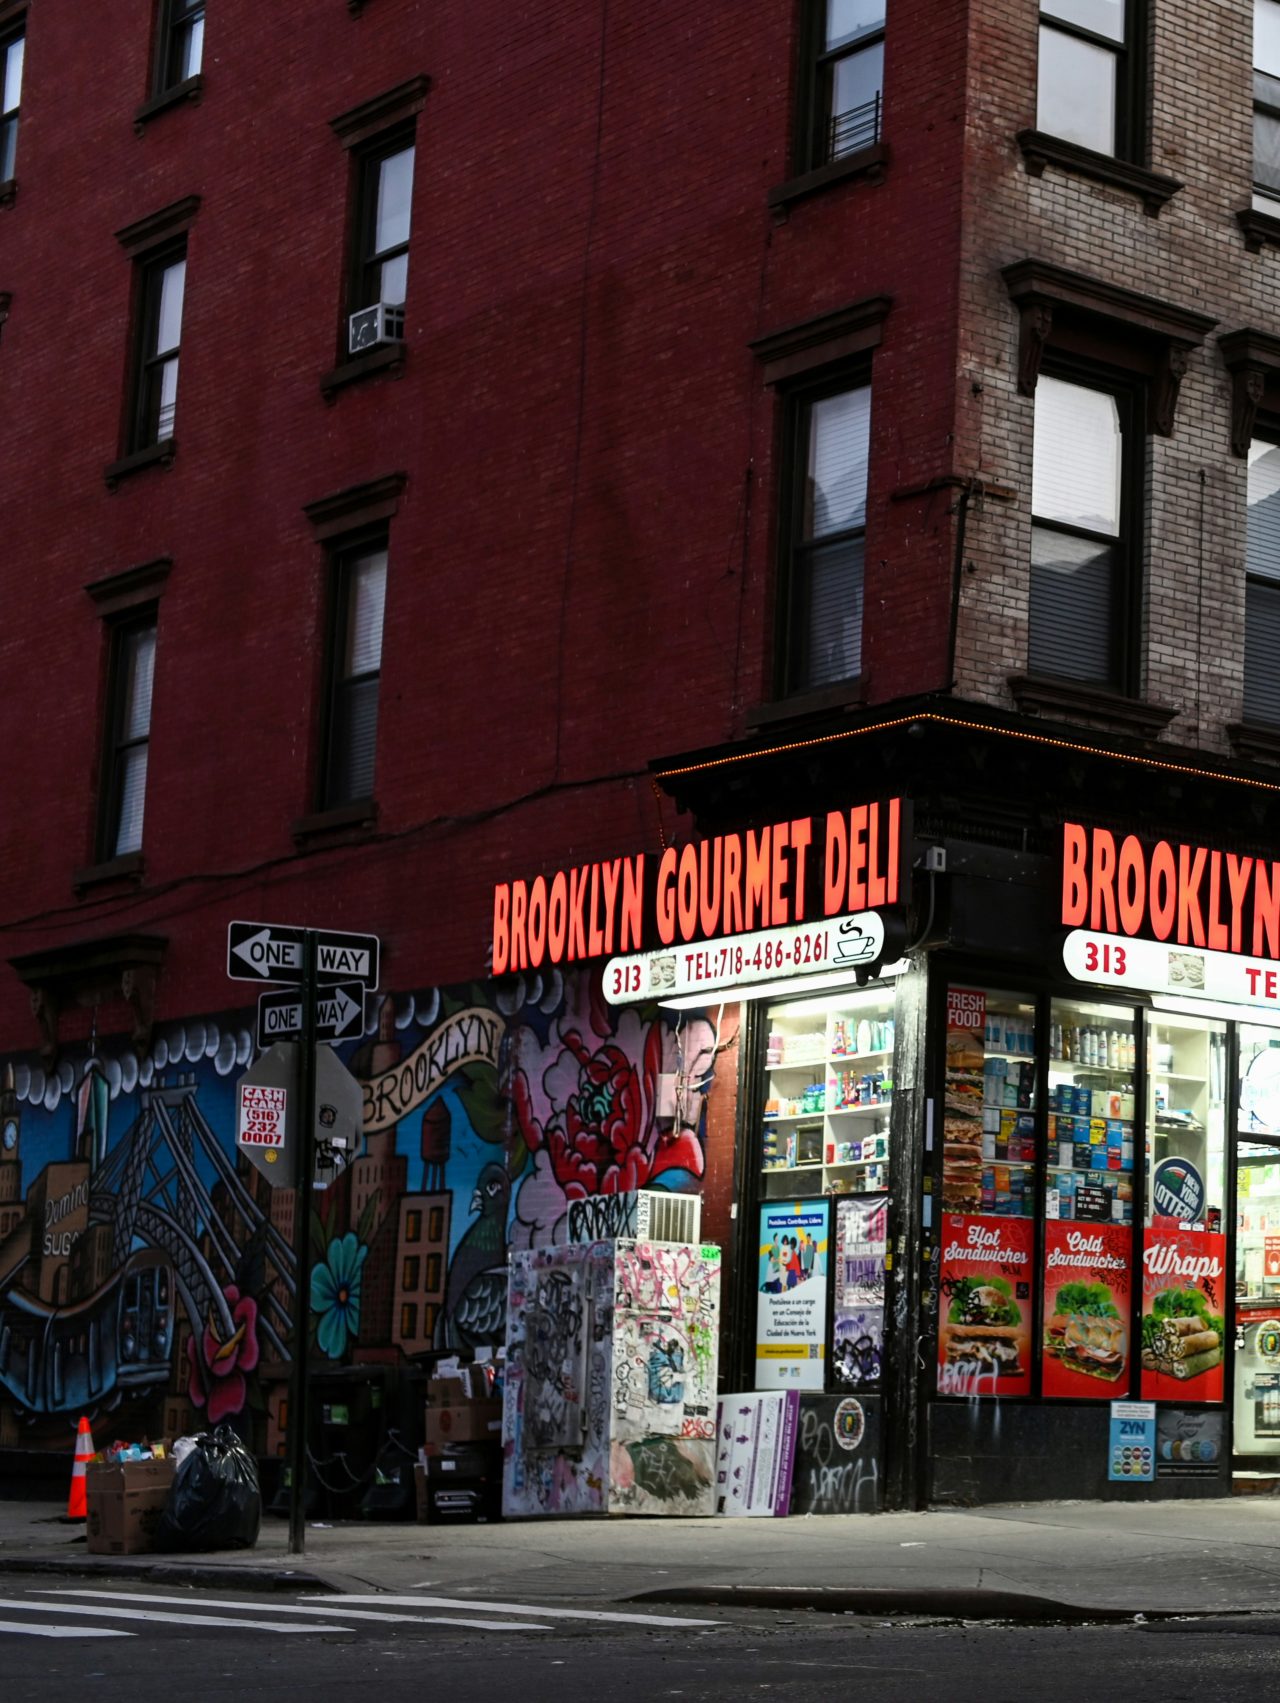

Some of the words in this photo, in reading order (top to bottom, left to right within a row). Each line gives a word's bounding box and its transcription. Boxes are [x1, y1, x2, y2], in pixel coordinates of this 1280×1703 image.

[492, 853, 644, 976] BROOKLYN
[656, 817, 812, 945] GOURMET
[824, 797, 901, 916] DELI
[250, 942, 295, 966] ONE
[320, 947, 365, 972] WAY
[612, 965, 643, 995] 313
[685, 932, 829, 983] TEL:718-486-8261
[1085, 943, 1127, 976] 313
[947, 992, 984, 1011] FRESH
[268, 1007, 298, 1030] ONE
[317, 1001, 349, 1024] WAY
[948, 1009, 981, 1027] FOOD
[362, 1014, 498, 1124] BROOKLYN
[244, 1099, 283, 1110] 4CARS
[247, 1109, 280, 1122] (516)
[242, 1132, 282, 1145] 0007
[247, 1121, 277, 1134] 232
[1184, 1173, 1201, 1195] NEW
[45, 1179, 90, 1228] Domino
[1179, 1183, 1200, 1210] YORK
[967, 1225, 1001, 1247] Hot
[1067, 1231, 1104, 1252] Cold
[944, 1245, 1029, 1265] Sandwiches
[1047, 1248, 1128, 1270] Sandwiches
[1143, 1243, 1223, 1282] Wraps
[1119, 1421, 1146, 1435] ZYN
